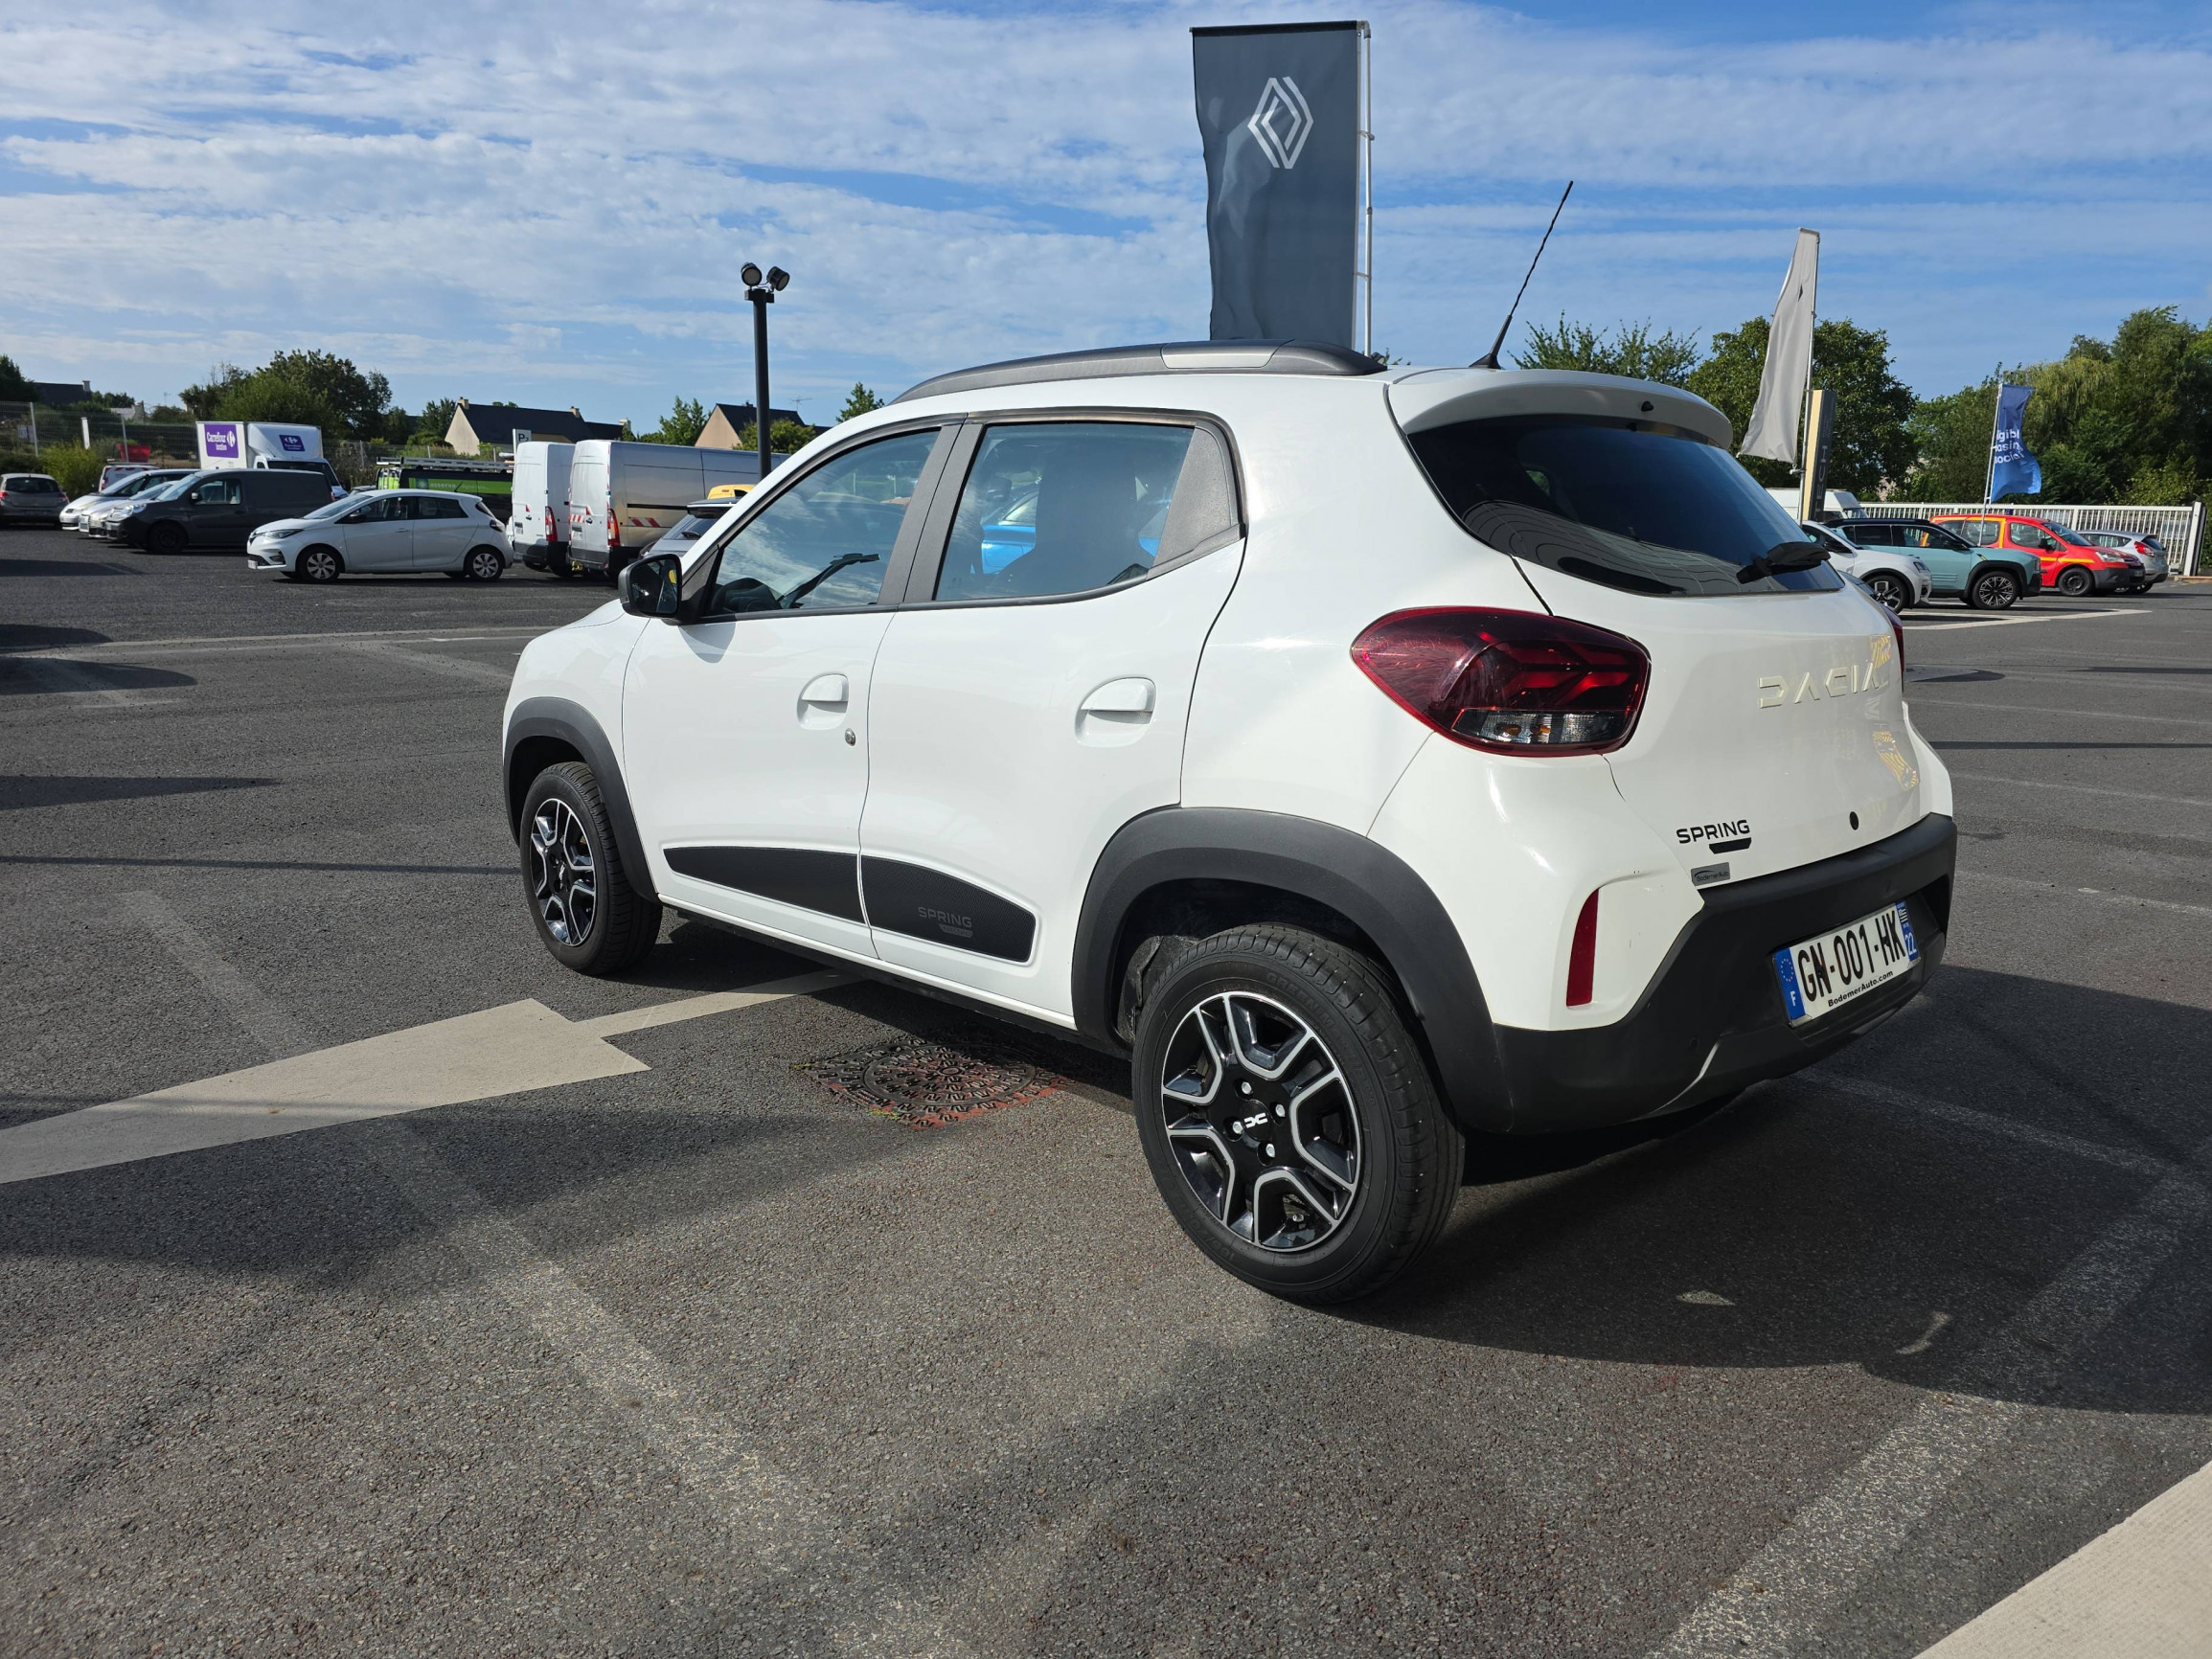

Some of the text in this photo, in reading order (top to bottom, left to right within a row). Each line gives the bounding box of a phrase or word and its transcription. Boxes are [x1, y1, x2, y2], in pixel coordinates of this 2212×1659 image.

[1758, 662, 1880, 709] DACIA
[1676, 819, 1750, 844] SPRING
[918, 906, 972, 928] SPRING
[1797, 910, 1905, 1002] GN-001-HK
[1828, 970, 1894, 1007] BodemerAuto.com
